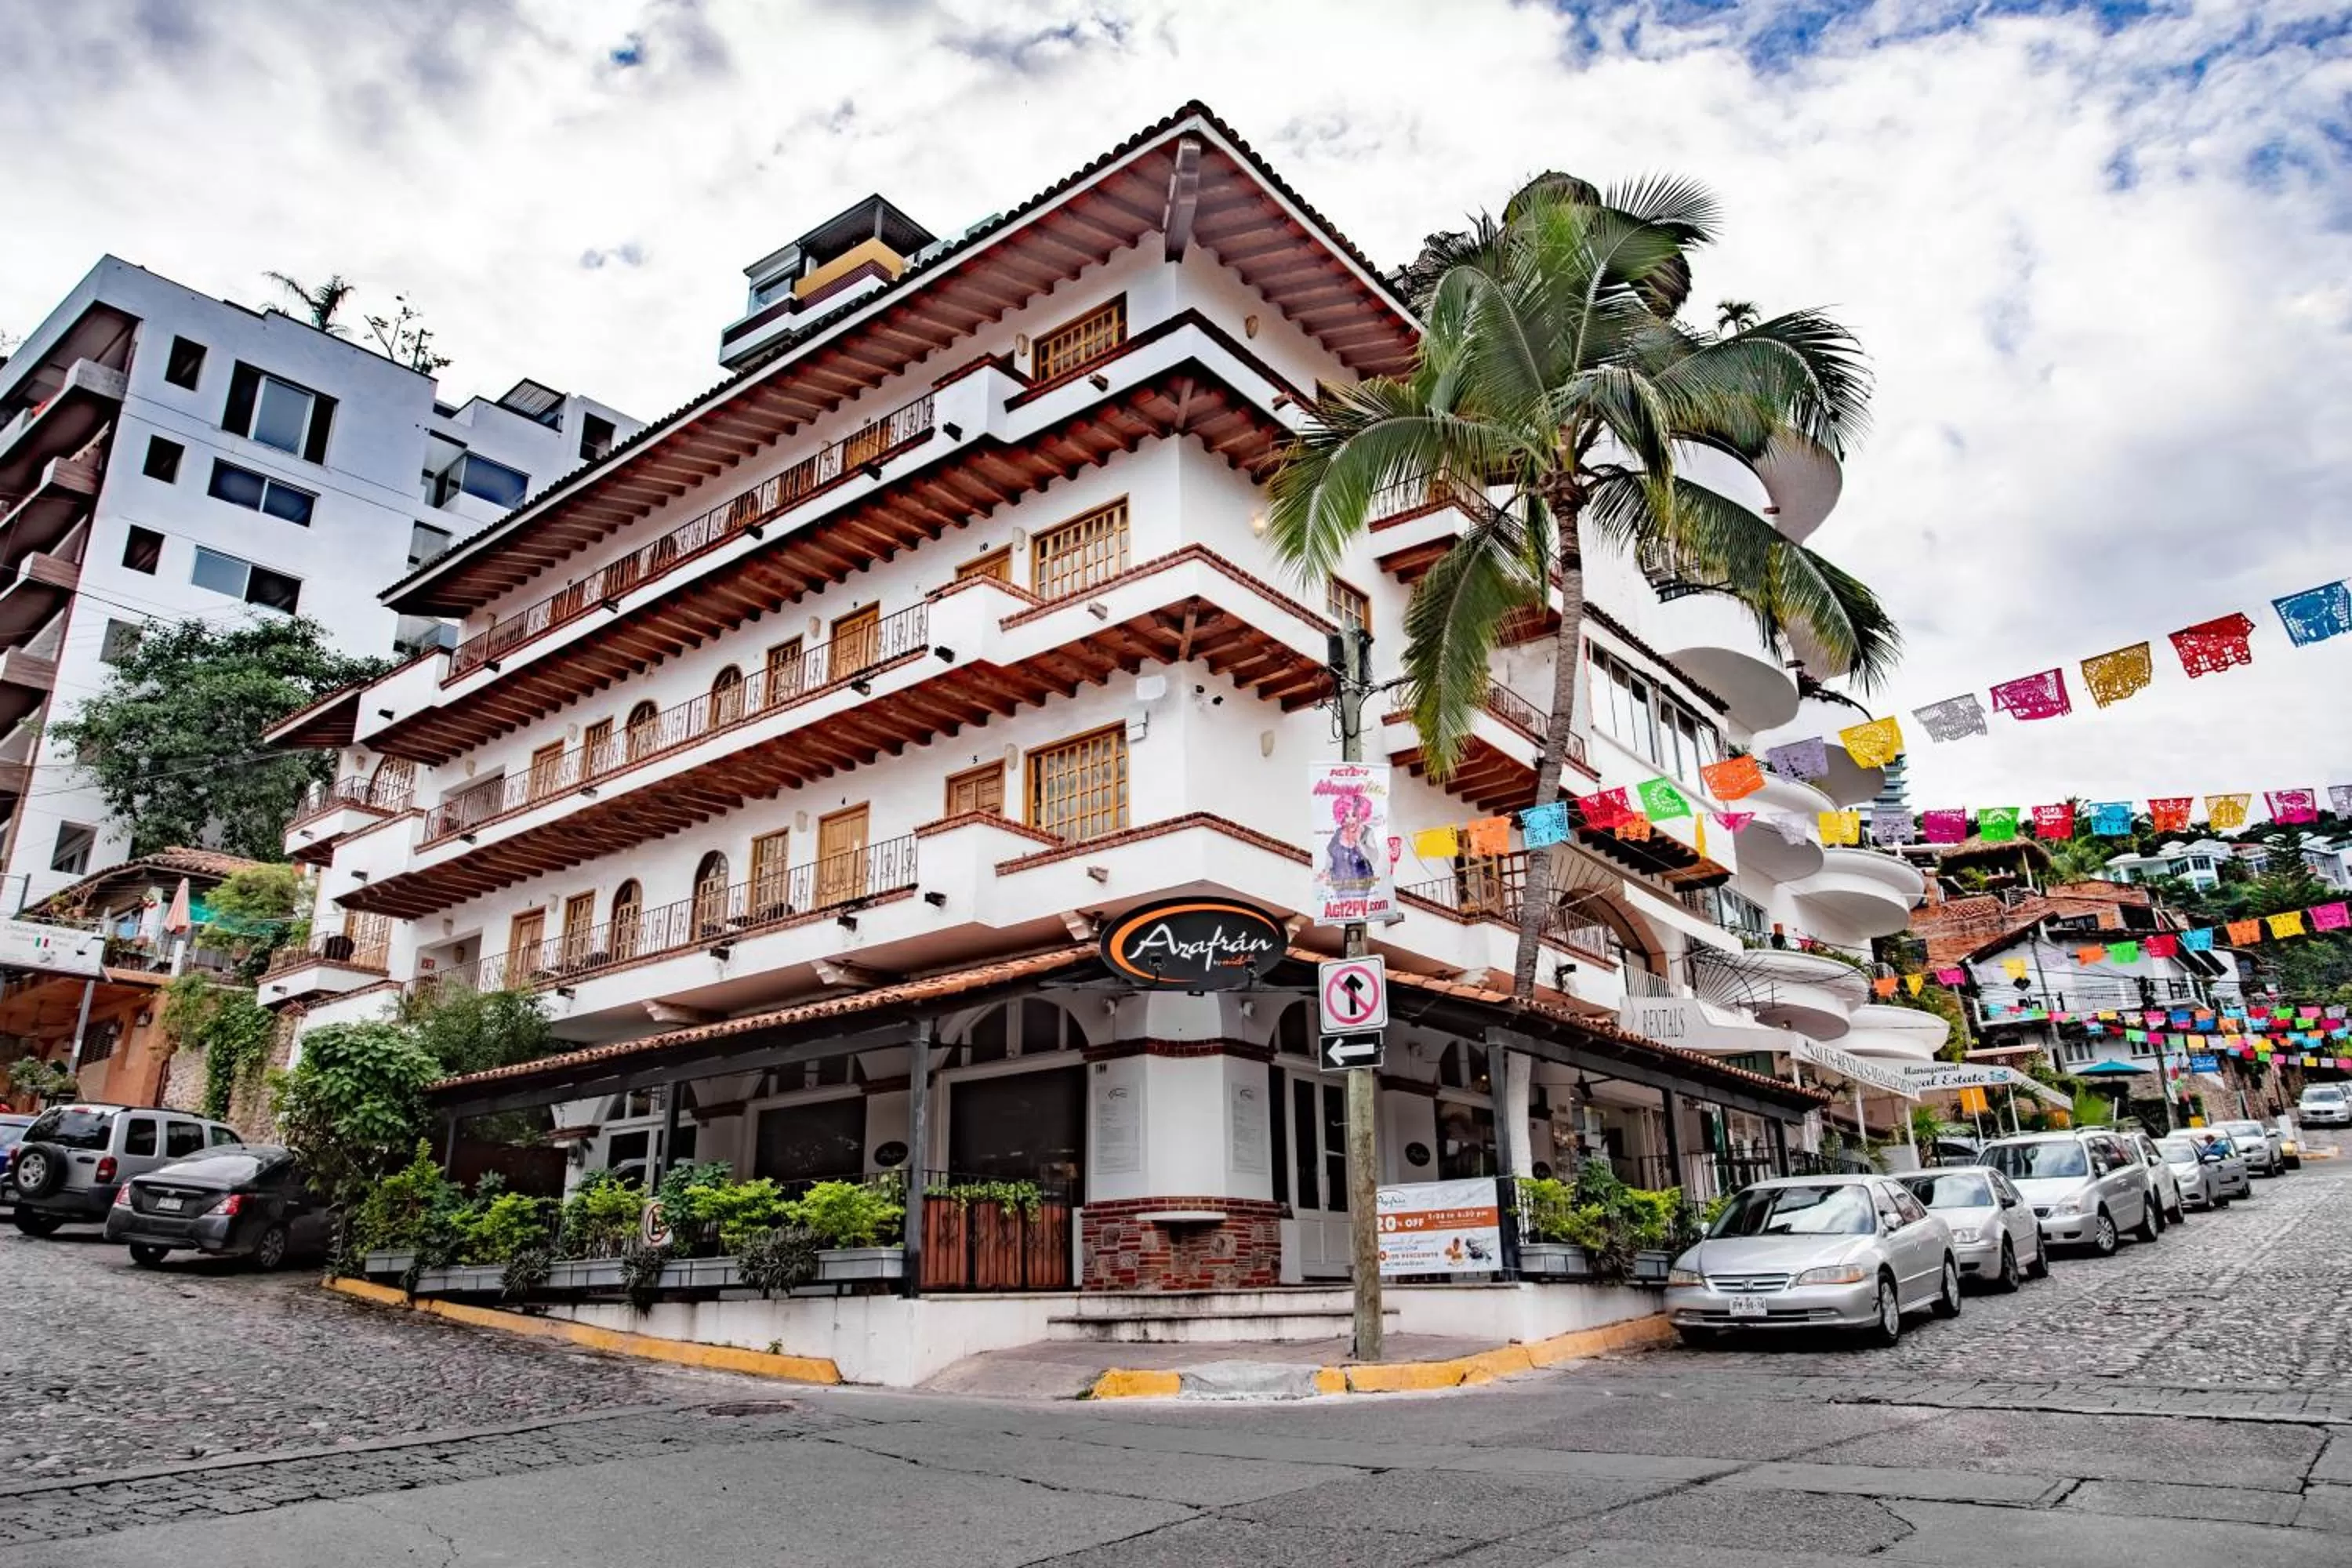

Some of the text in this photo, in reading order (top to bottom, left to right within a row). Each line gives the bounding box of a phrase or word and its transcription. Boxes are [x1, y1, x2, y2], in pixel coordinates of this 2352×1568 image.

[1324, 899, 1388, 918] Act2PV.com
[1127, 923, 1272, 972] Azafrán
[1642, 1007, 1686, 1038] RENTALS
[1941, 1073, 1986, 1086] Estate
[1405, 1218, 1425, 1228] OFF
